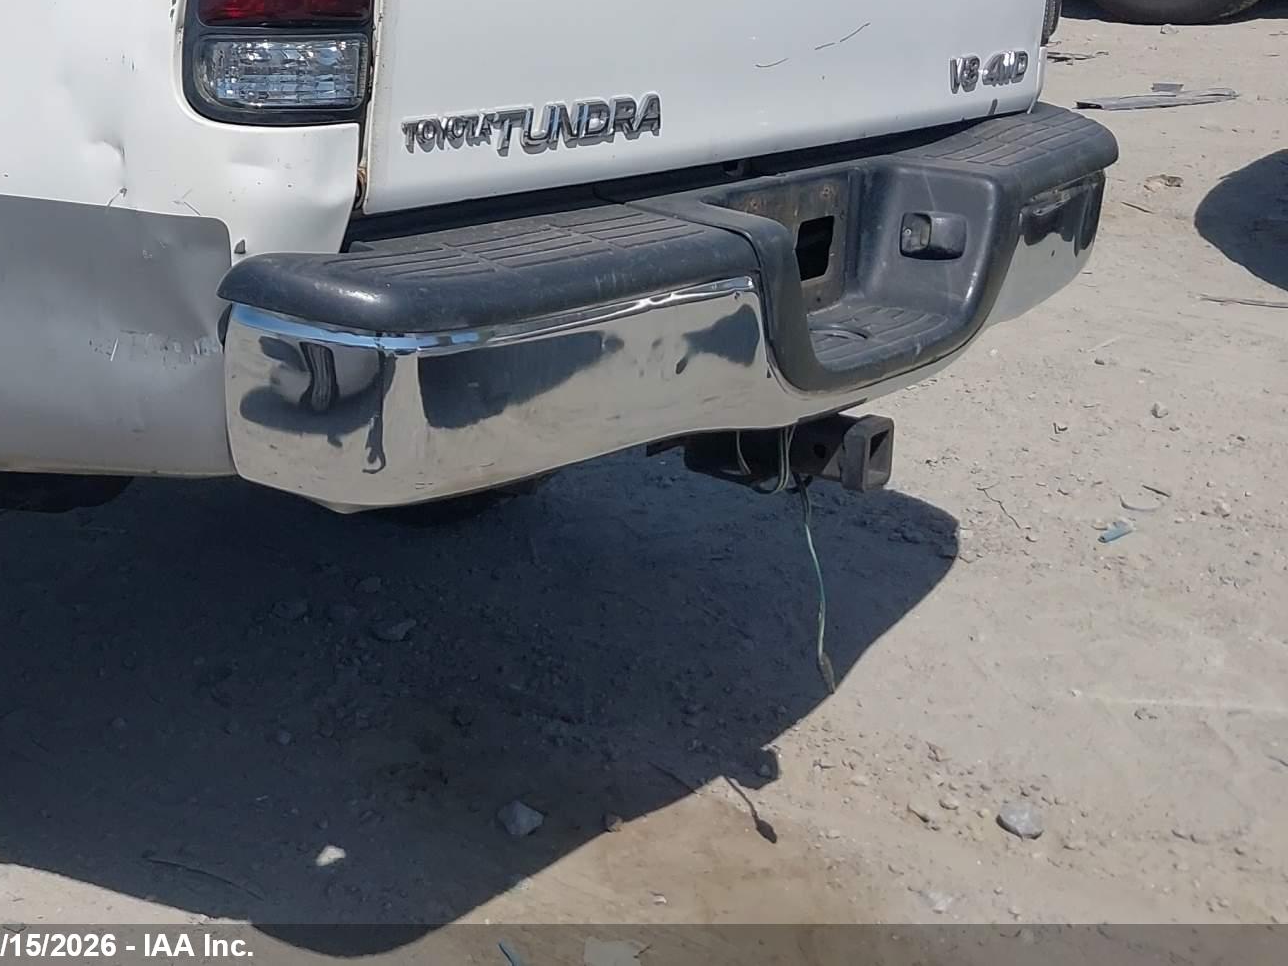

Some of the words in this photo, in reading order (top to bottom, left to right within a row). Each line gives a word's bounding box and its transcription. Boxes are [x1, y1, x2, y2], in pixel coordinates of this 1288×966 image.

[950, 55, 980, 94] V8
[401, 112, 494, 154] TOYOTA
[489, 93, 662, 157] TUNDRA
